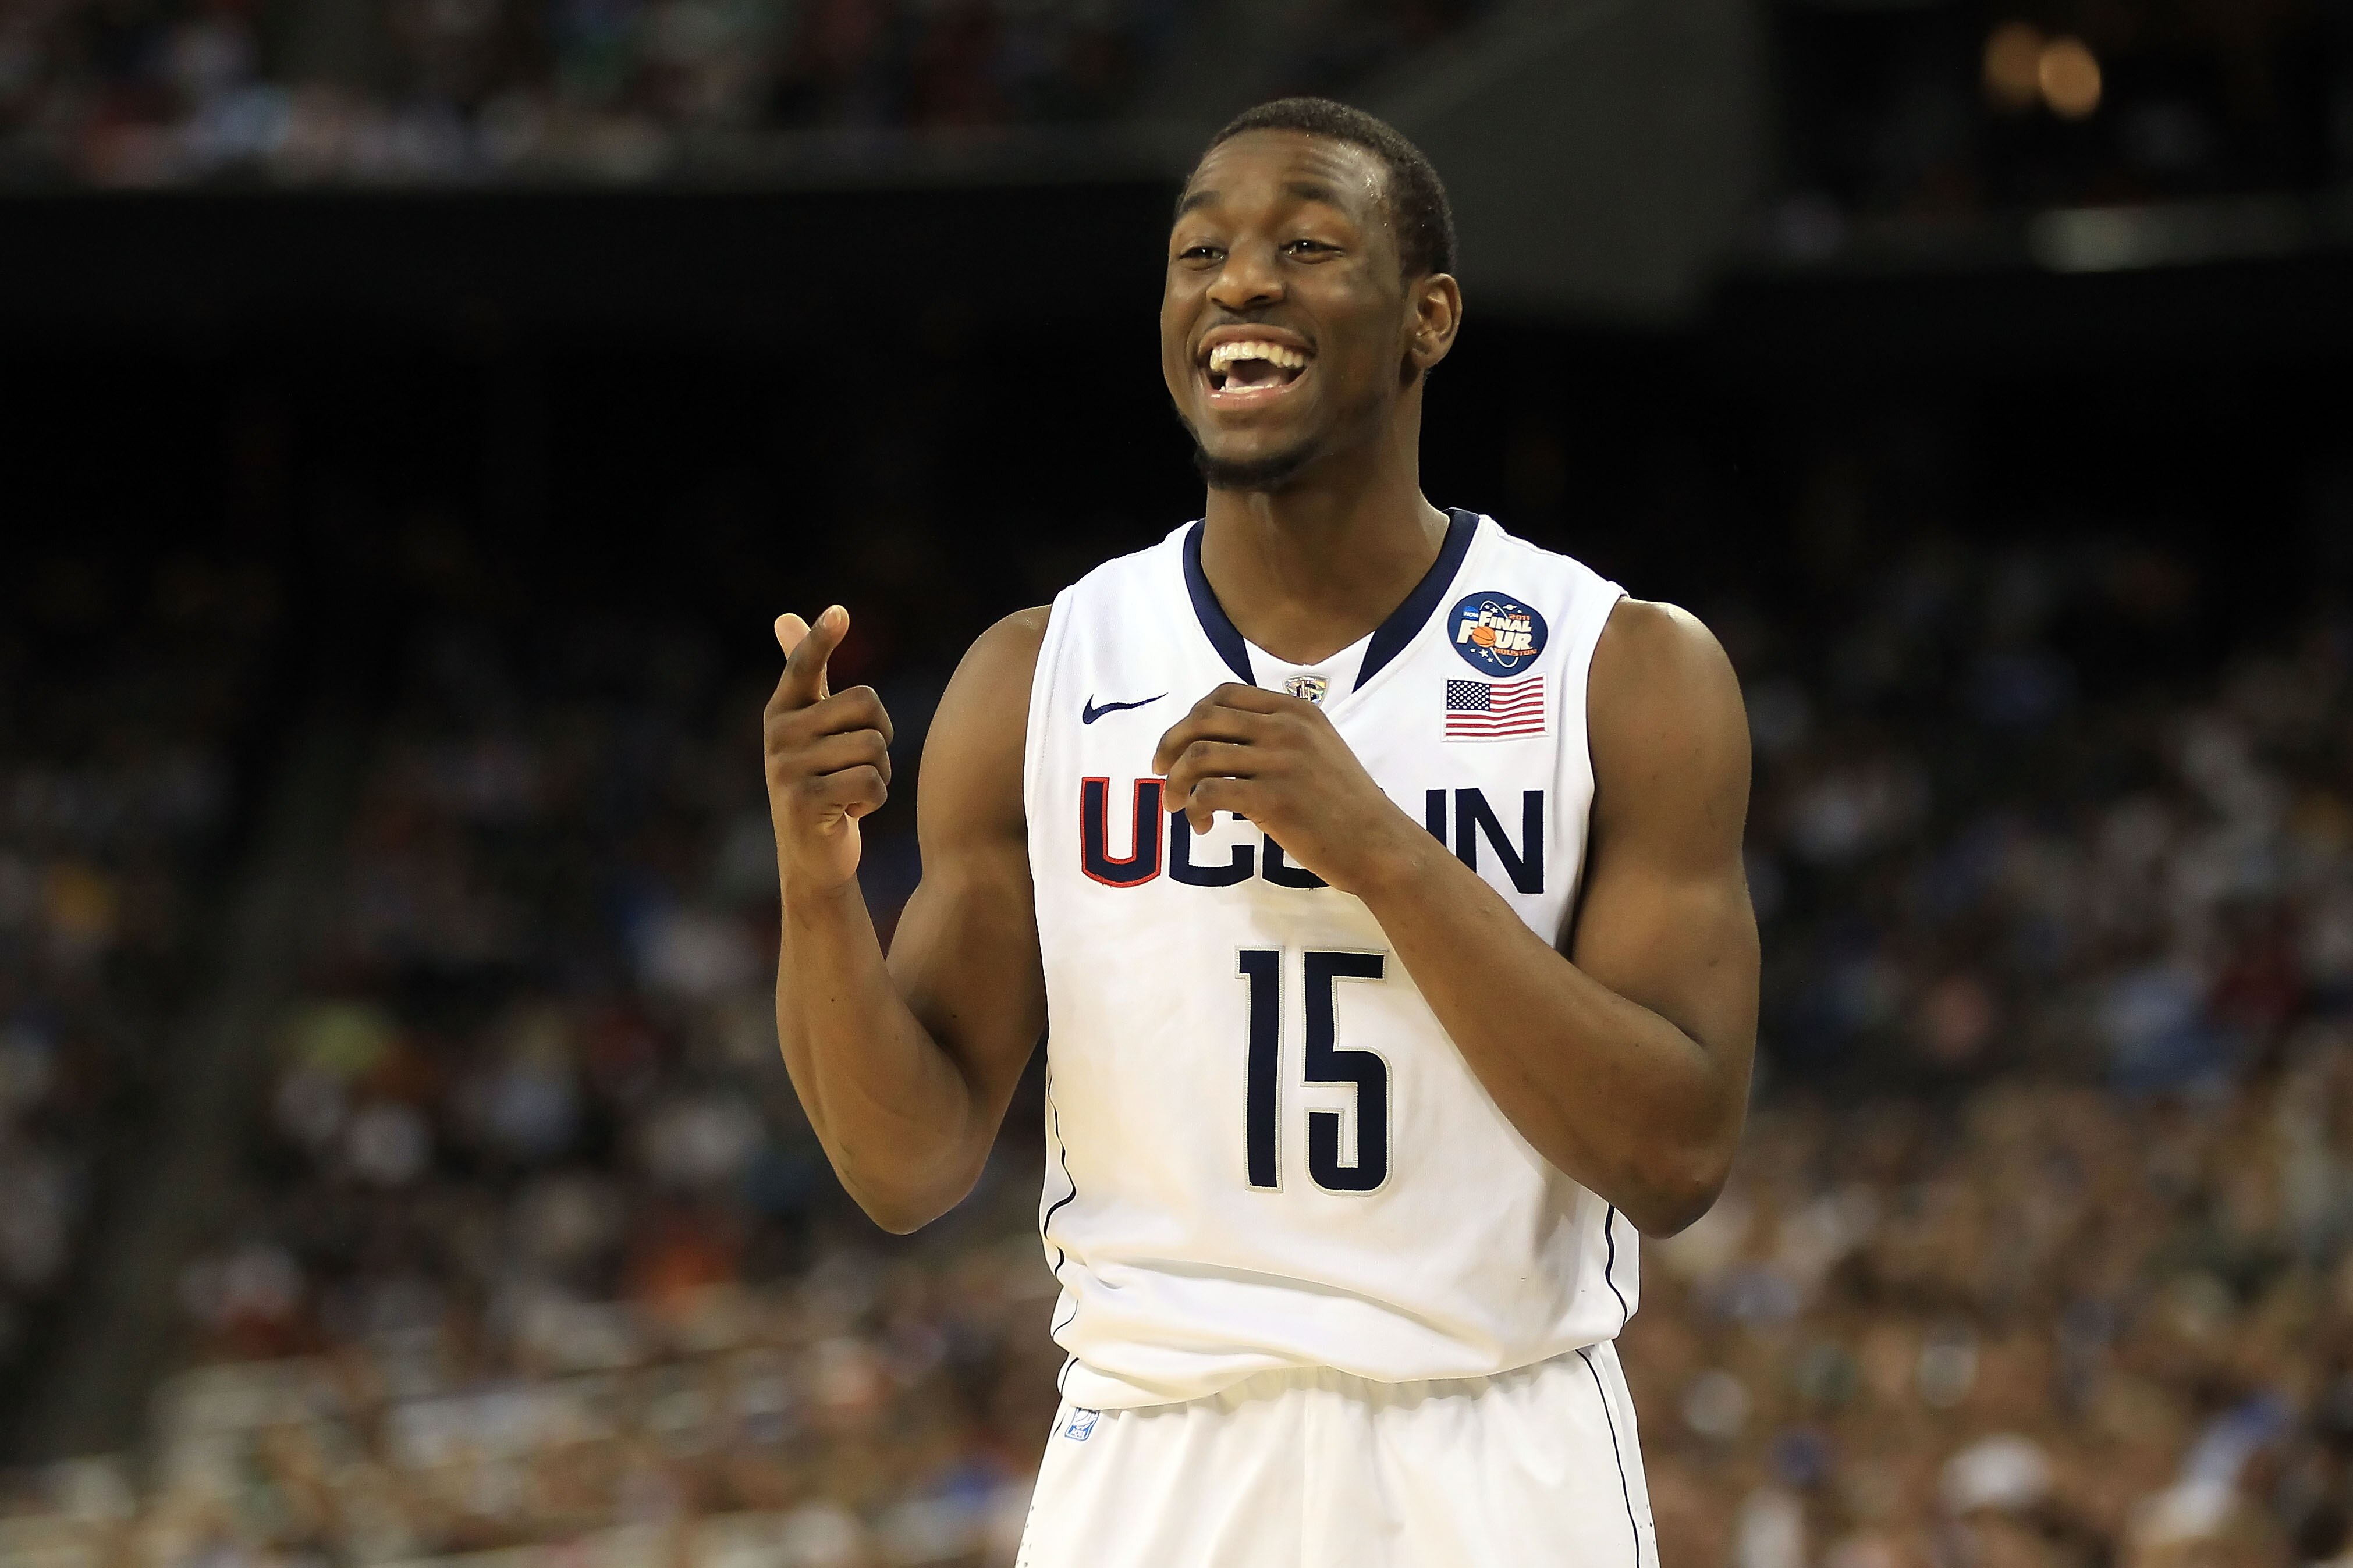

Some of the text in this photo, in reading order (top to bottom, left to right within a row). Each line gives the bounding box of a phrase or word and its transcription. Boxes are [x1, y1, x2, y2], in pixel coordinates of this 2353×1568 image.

[1456, 619, 1533, 650] FOUR
[1478, 611, 1532, 632] FINAL
[1494, 648, 1538, 657] HOUSTON
[1080, 776, 1544, 895] UCN
[1234, 945, 1393, 1196] 15
